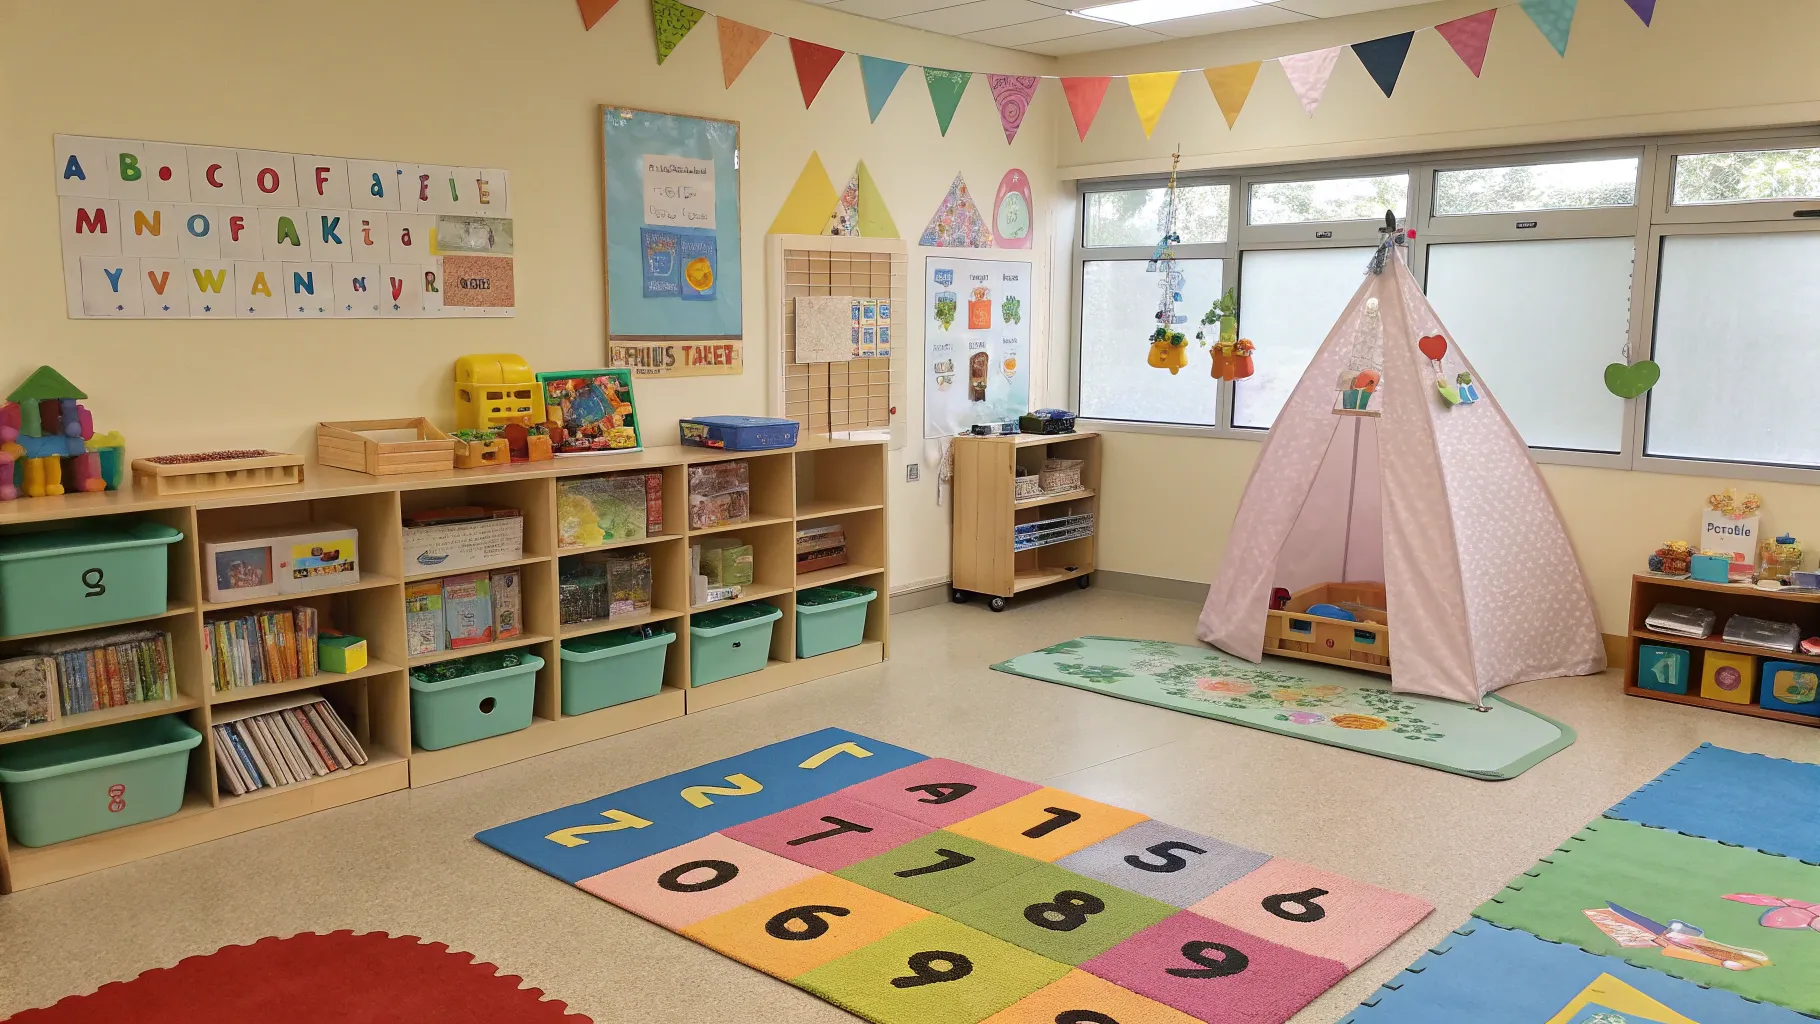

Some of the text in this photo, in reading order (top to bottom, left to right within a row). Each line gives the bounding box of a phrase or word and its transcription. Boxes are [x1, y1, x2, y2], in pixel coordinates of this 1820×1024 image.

[63, 154, 87, 181] A
[118, 152, 142, 182] B
[205, 163, 224, 189] C
[256, 167, 280, 194] O
[314, 166, 331, 196] F
[75, 207, 108, 235] M
[133, 210, 161, 237] N
[186, 213, 210, 238] O
[229, 215, 245, 242] F
[277, 216, 302, 247] A
[320, 215, 343, 245] K
[103, 267, 124, 293] Y
[147, 270, 171, 296] V
[192, 268, 226, 294] W
[251, 271, 272, 298] A
[293, 271, 315, 296] N
[786, 815, 874, 846] T
[1023, 889, 1106, 933] 8
[1165, 940, 1250, 980] 9
[1123, 840, 1208, 874] 5
[1261, 887, 1329, 923] 6
[765, 904, 851, 941] 6
[890, 950, 974, 989] 9
